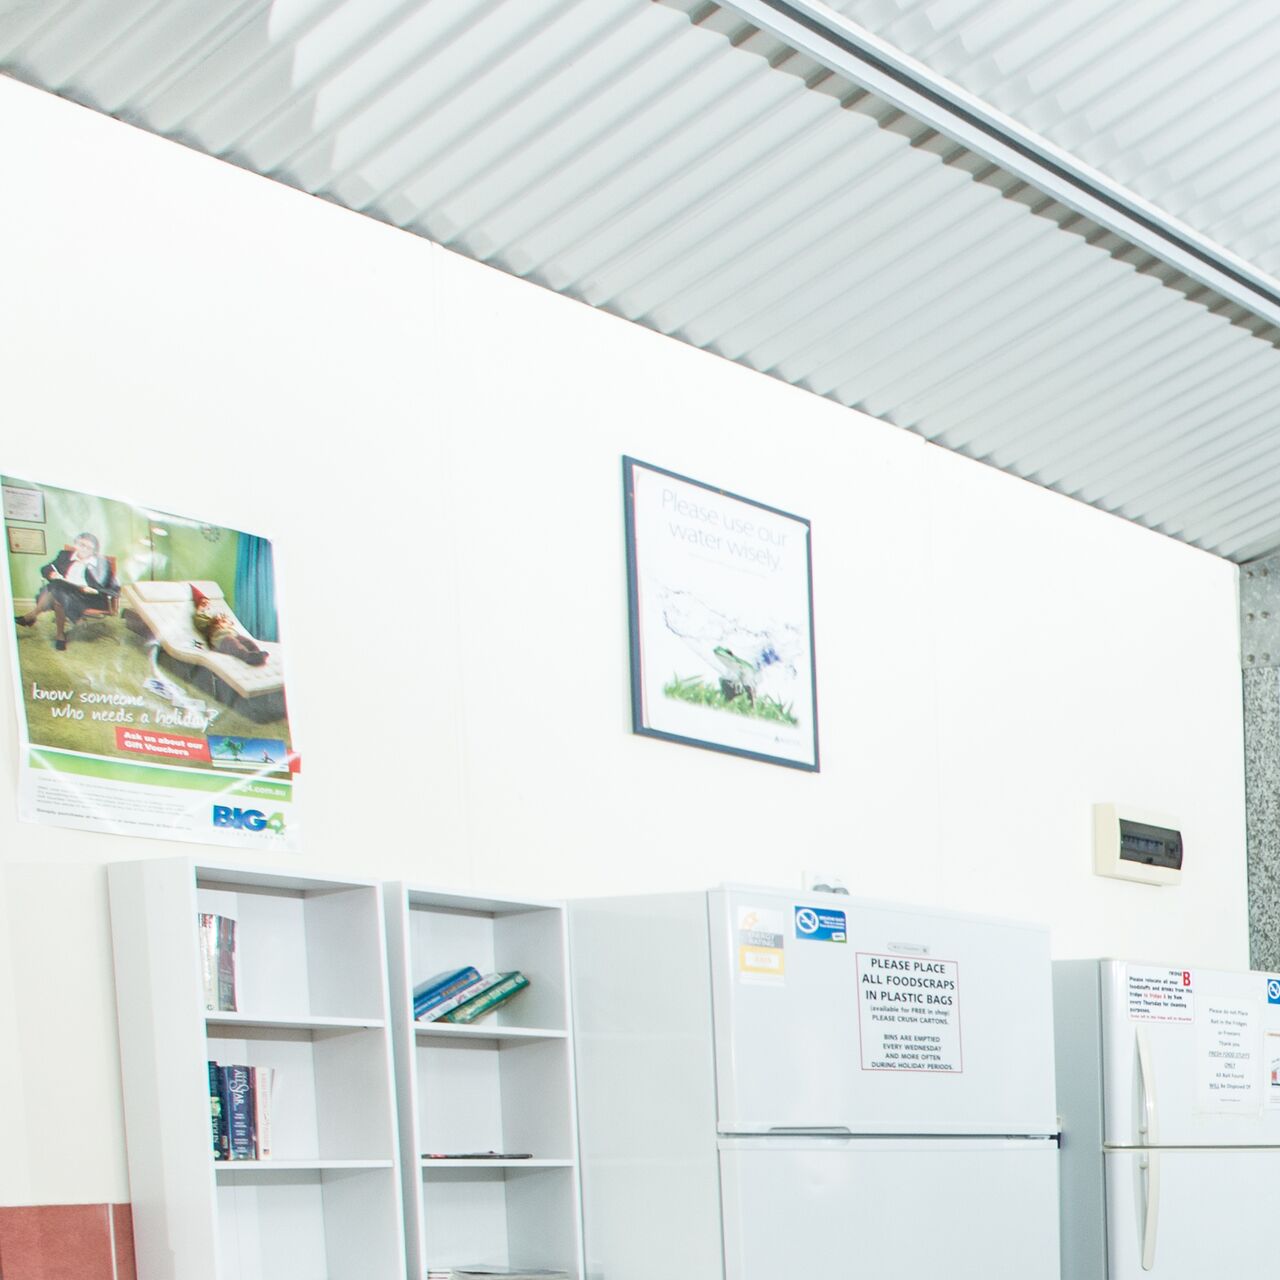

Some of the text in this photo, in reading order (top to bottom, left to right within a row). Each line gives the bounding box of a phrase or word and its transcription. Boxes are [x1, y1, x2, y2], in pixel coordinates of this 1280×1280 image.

[662, 488, 788, 547] Please use our
[668, 521, 783, 572] water wisely.
[32, 682, 144, 706] know someone
[51, 703, 219, 733] who needs a holiday?
[123, 731, 203, 750] Ask us about our
[124, 740, 189, 756] Gift Vouchers
[214, 805, 286, 834] BIG4
[871, 958, 945, 974] PLEASE PLACE
[862, 974, 955, 990] ALL FOODSCRAPS
[1183, 971, 1190, 986] B
[866, 990, 952, 1005] IN PLASTIC BAGS
